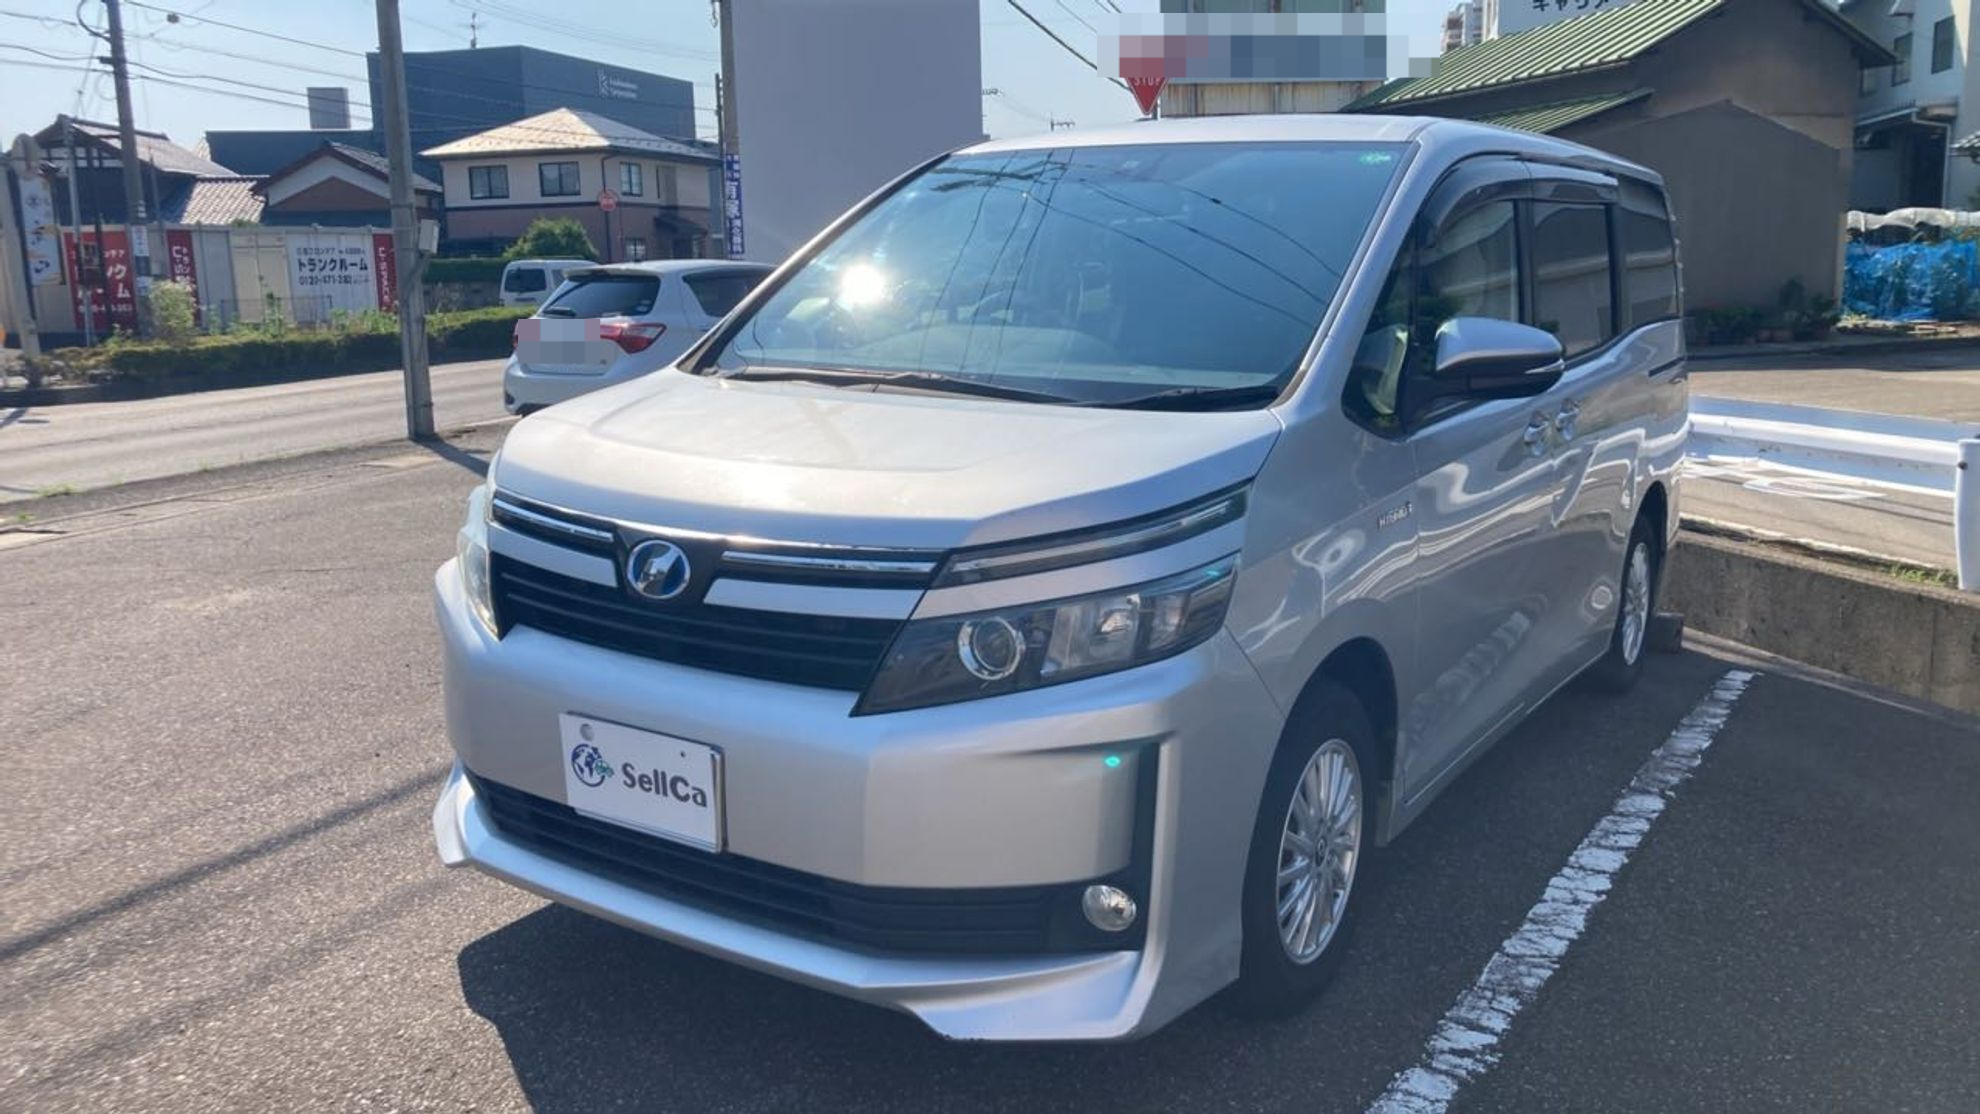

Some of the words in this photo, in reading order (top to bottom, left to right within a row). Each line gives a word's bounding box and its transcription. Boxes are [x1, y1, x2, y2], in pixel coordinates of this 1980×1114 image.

[297, 258, 368, 272] トランクルーム
[621, 762, 707, 808] SellCa
